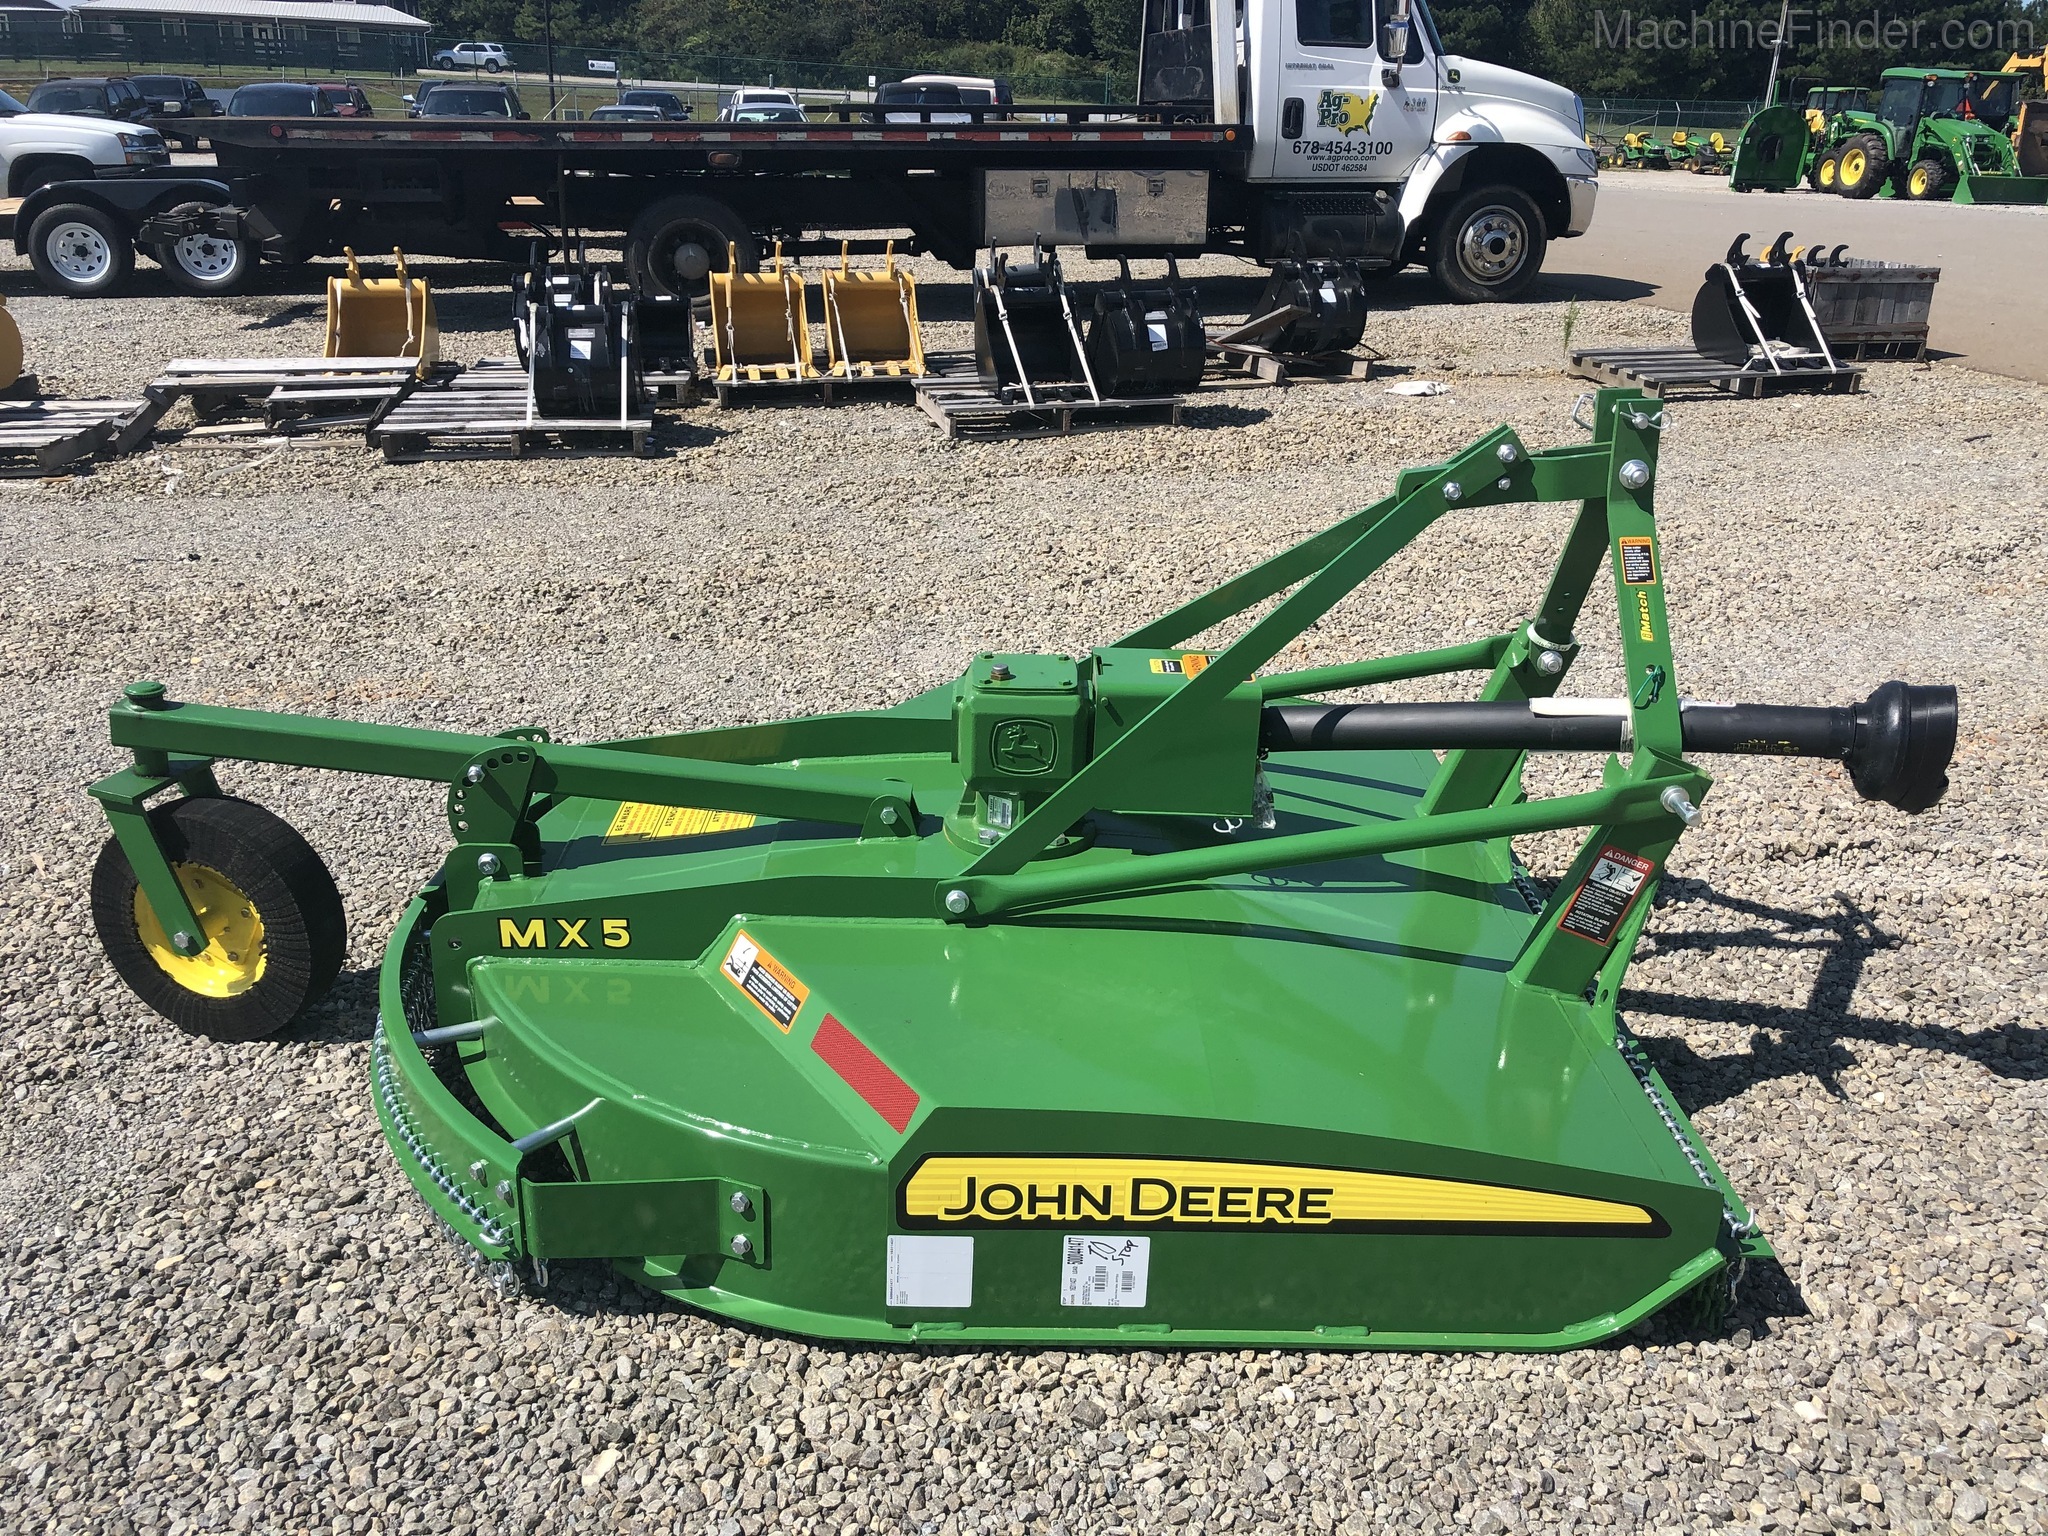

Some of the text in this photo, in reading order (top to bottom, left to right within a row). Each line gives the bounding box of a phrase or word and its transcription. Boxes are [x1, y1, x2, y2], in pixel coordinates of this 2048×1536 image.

[1317, 108, 1351, 127] Pro
[1293, 140, 1393, 155] 678-454-3100
[1306, 154, 1377, 162] www.agproco.com
[1312, 163, 1368, 172] USDOT 462584
[1614, 852, 1649, 871] DANGER
[773, 964, 796, 989] WARNING
[943, 1176, 1334, 1219] JOHN DEERE
